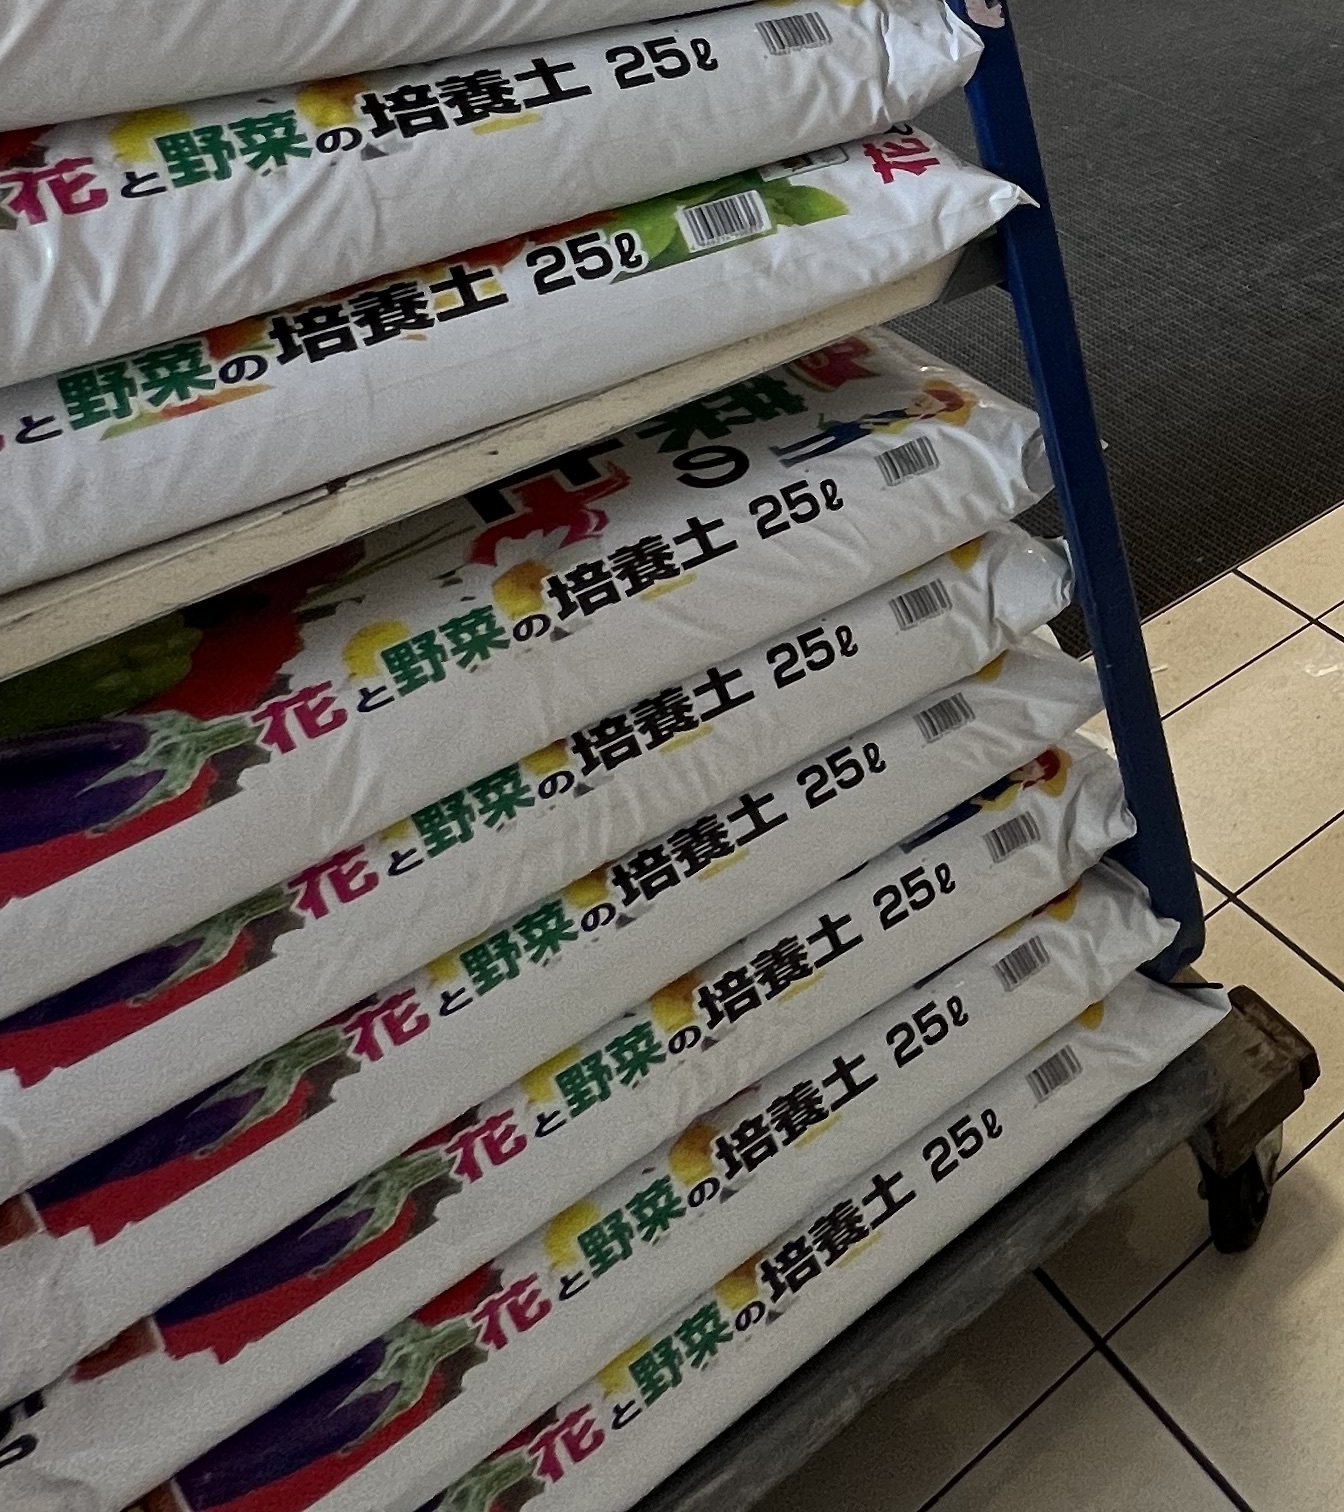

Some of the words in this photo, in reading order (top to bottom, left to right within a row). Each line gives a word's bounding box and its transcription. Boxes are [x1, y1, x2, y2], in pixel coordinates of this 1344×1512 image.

[6, 54, 593, 226] 花と野菜の培養土
[253, 514, 738, 758] 花と野菜の培養土
[287, 647, 757, 925] 花と野菜の培養土
[344, 786, 790, 1066] 花と野菜の培養土
[447, 909, 864, 1186] 花と野菜の培養土
[472, 1050, 878, 1353] 花と野菜の培養土
[529, 1172, 919, 1485] 花と野菜の培養土
